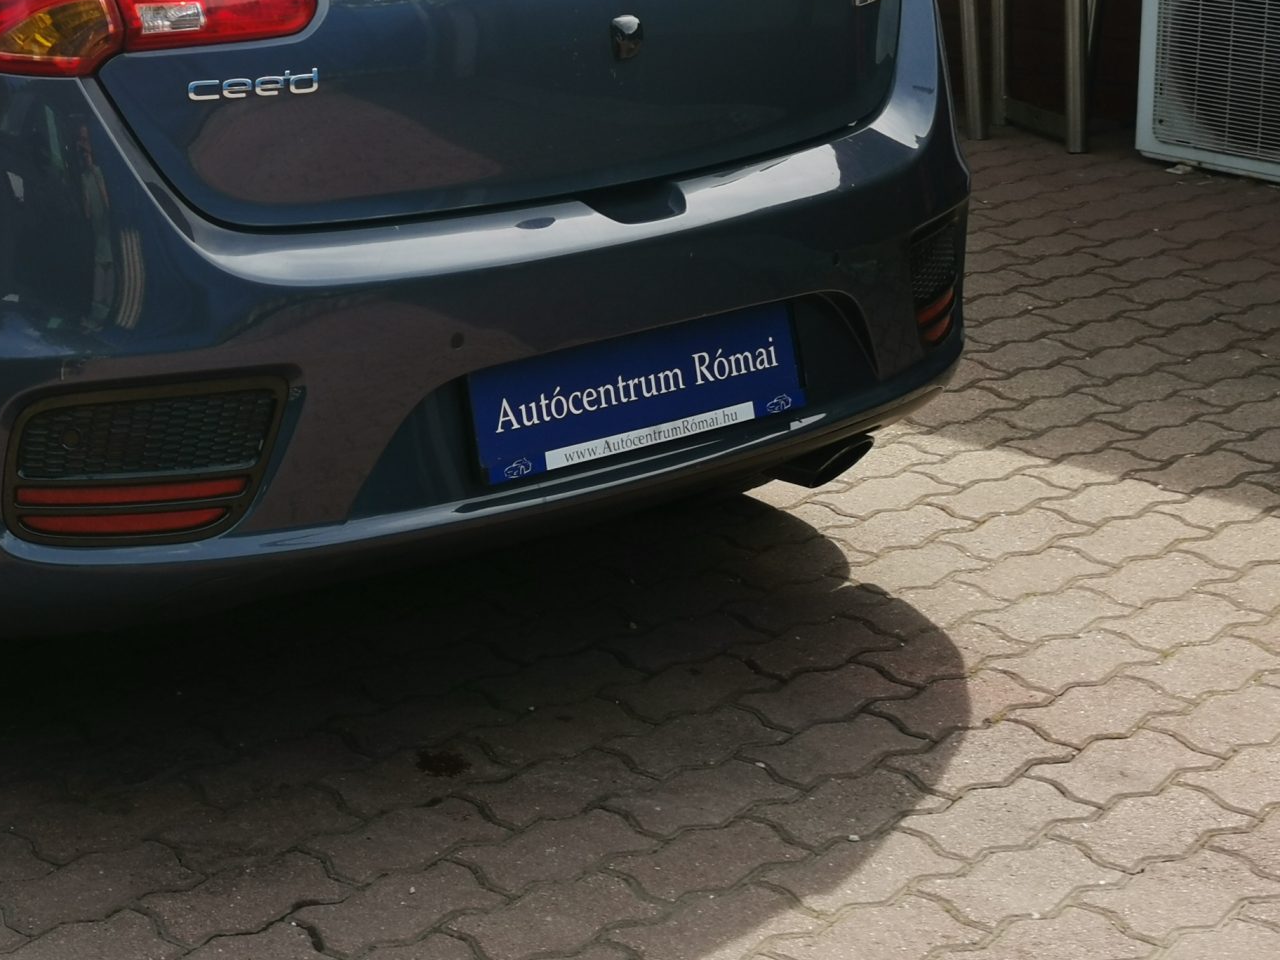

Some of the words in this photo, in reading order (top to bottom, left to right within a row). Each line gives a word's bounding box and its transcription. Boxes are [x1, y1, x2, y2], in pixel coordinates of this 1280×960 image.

[495, 367, 686, 434] Autócentrum
[692, 336, 779, 387] Római
[564, 409, 739, 465] www.AutócentrumRómai.hu
